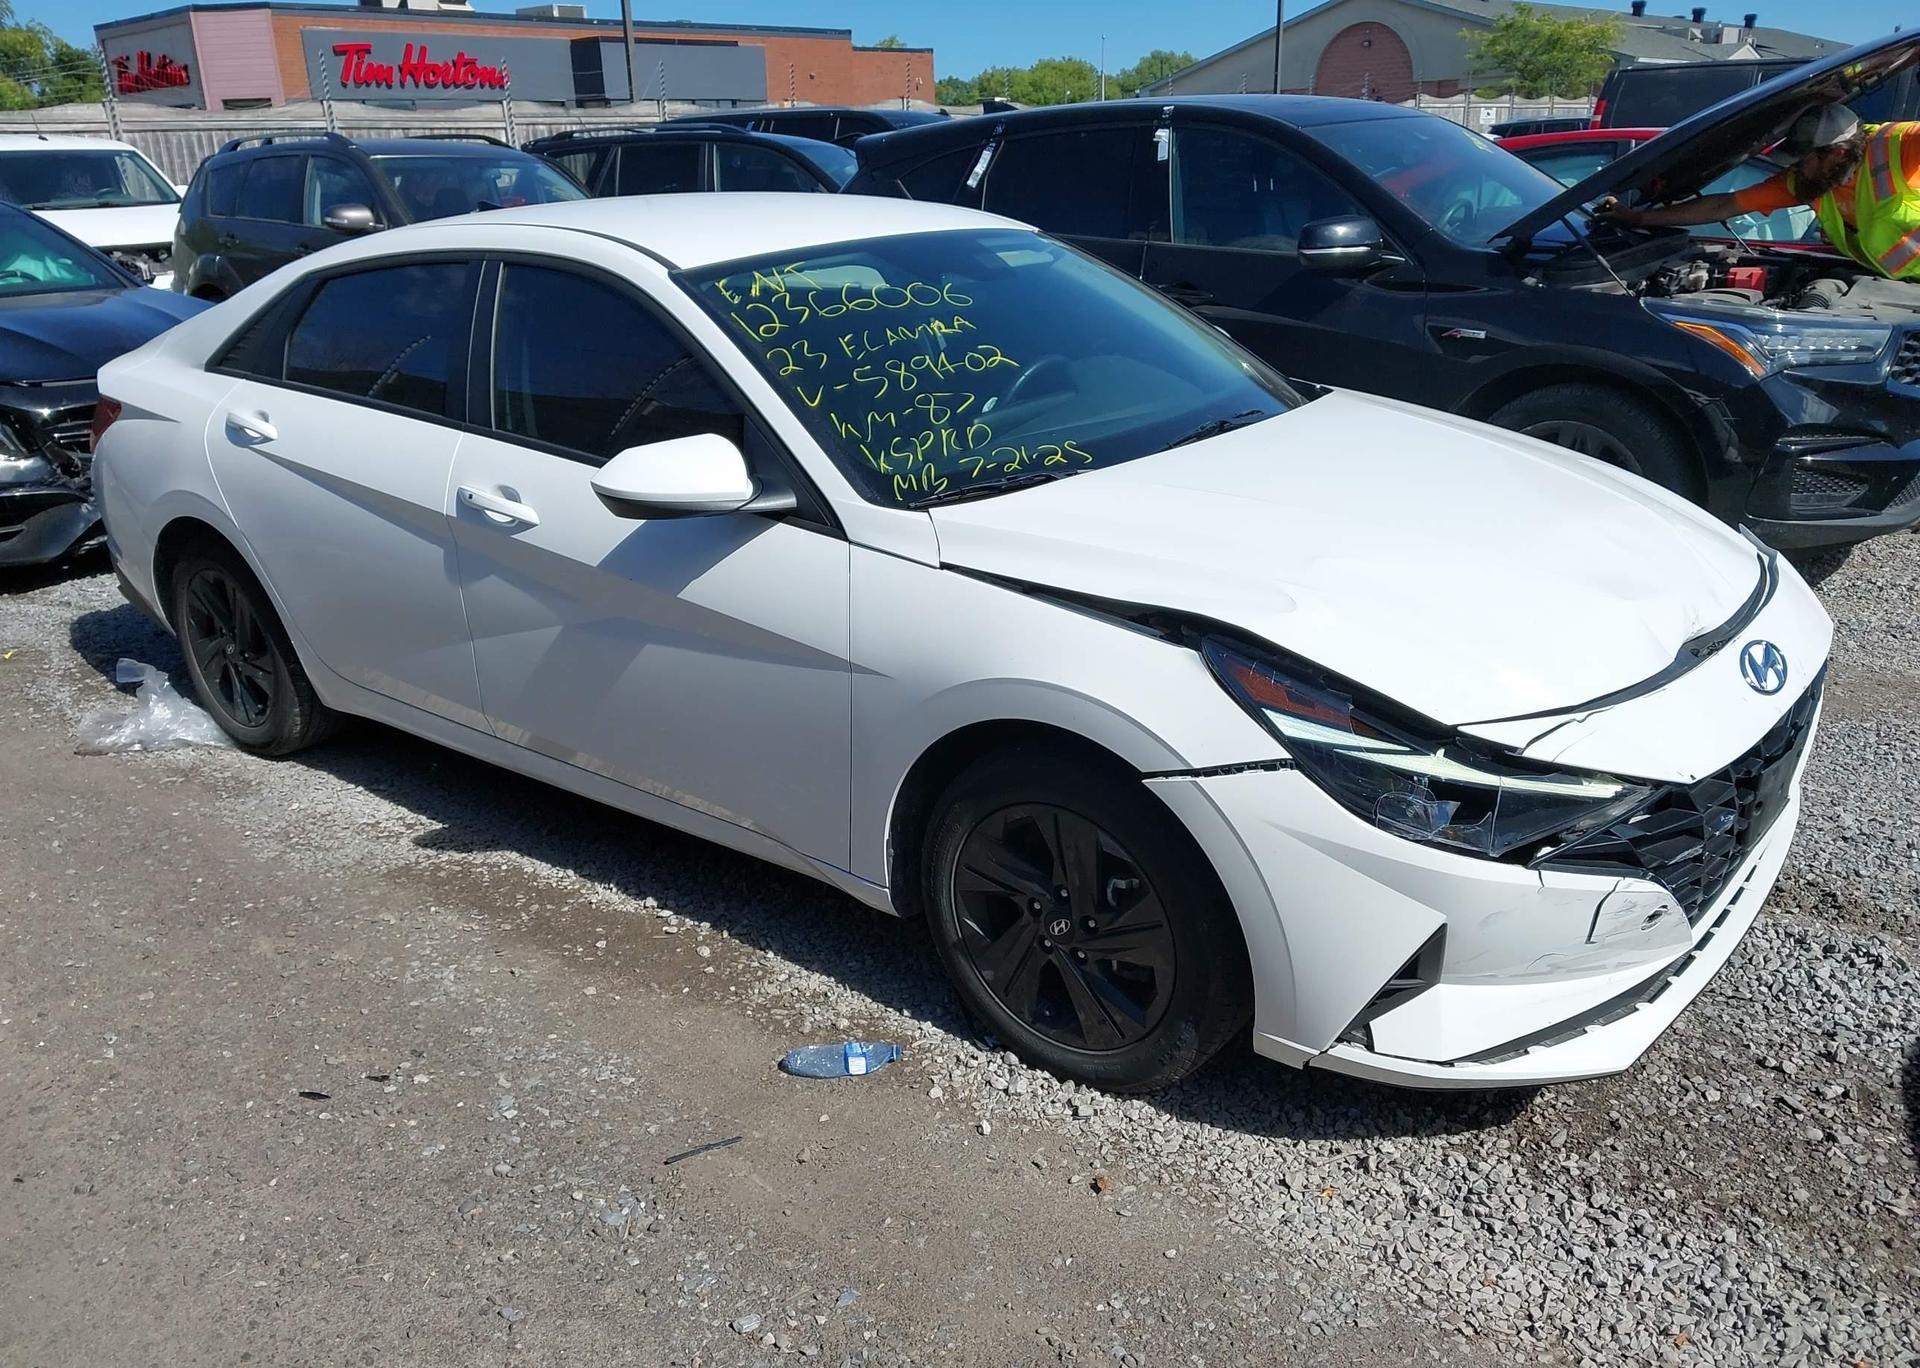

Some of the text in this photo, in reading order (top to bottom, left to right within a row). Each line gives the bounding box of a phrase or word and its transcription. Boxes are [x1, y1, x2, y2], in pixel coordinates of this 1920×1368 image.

[332, 43, 394, 88] Tim
[715, 261, 823, 304] ENT
[730, 282, 974, 342] 12366006
[766, 339, 828, 376] 23
[893, 463, 949, 501] MB
